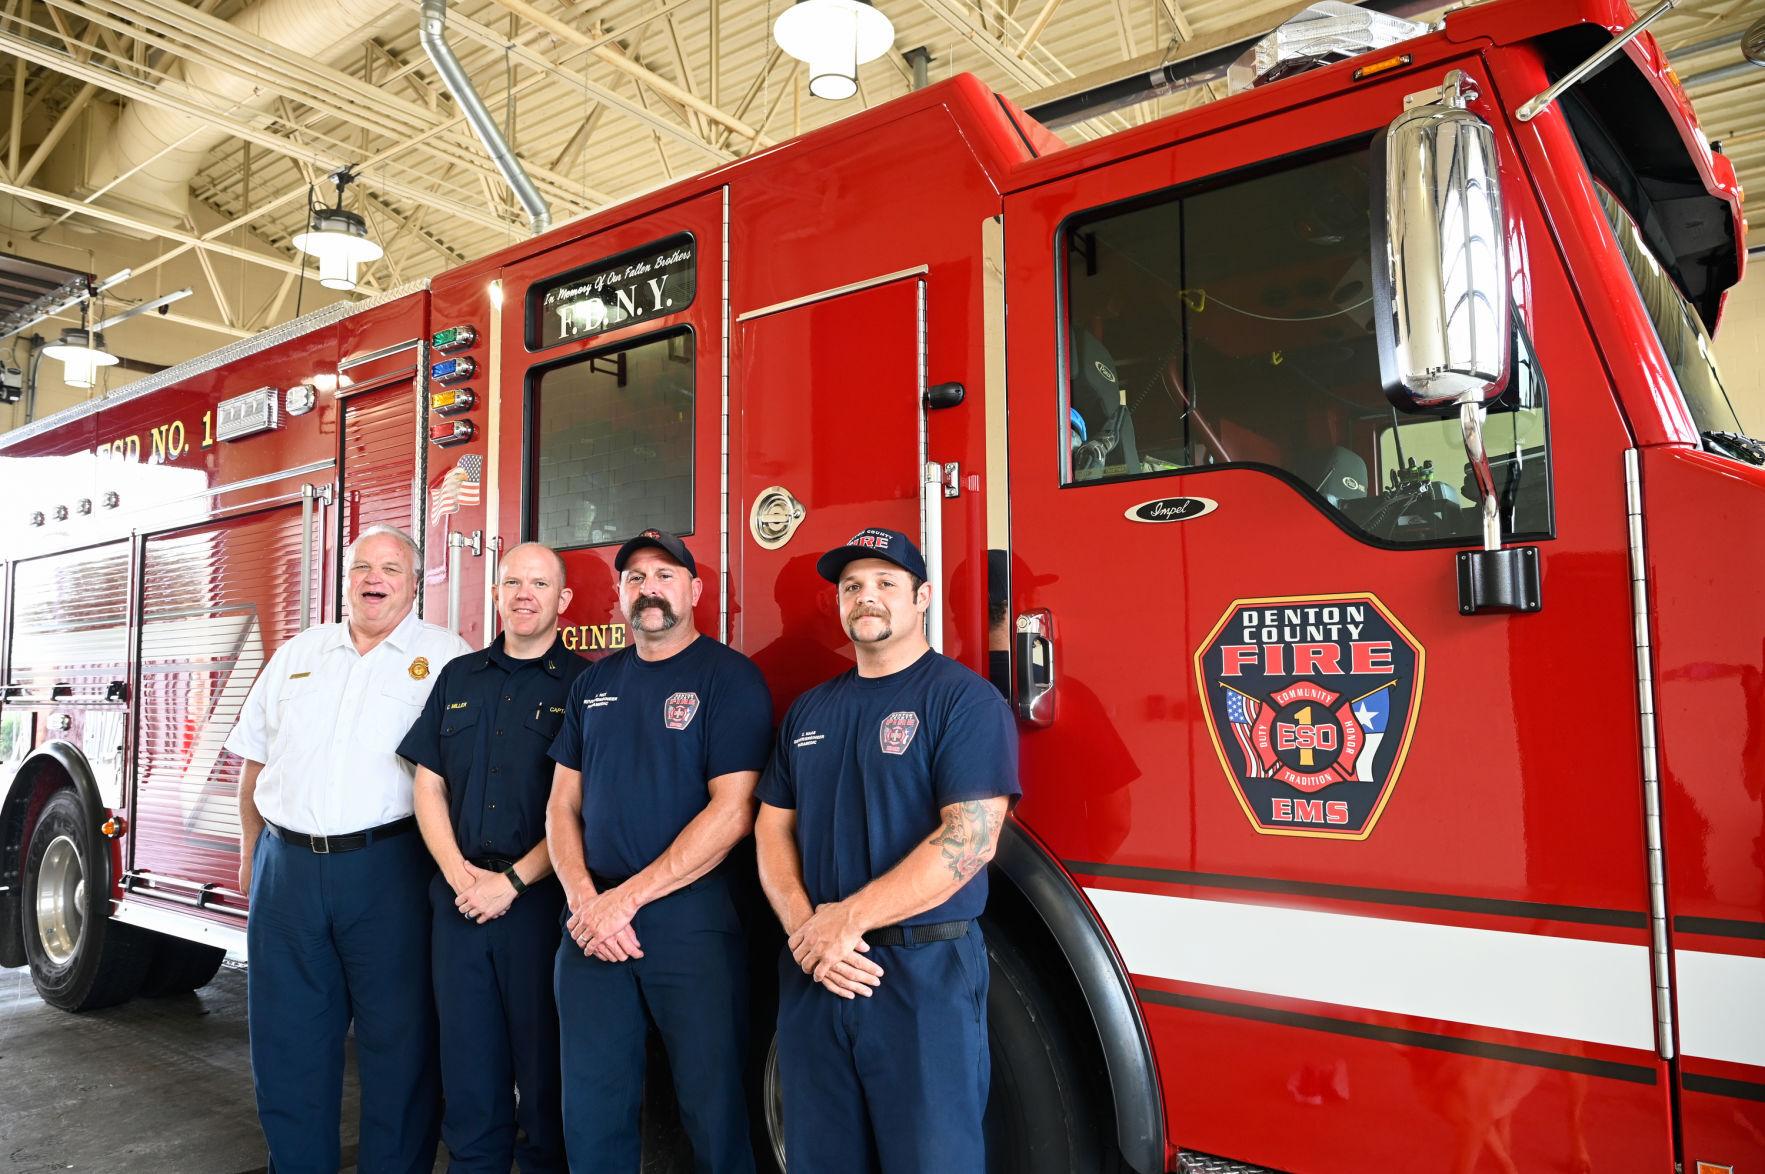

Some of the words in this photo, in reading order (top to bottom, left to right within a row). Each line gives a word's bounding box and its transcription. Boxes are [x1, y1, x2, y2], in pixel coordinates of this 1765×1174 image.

[543, 293, 555, 306] In
[557, 283, 592, 301] Memory
[594, 276, 605, 292] Of
[606, 271, 622, 285] Our
[624, 263, 652, 280] Fallen
[654, 250, 692, 269] Brothers
[149, 420, 190, 464] NO.
[202, 410, 213, 447] 1
[1150, 499, 1191, 520] Impel
[866, 529, 894, 540] COUNTY
[1243, 606, 1365, 627] DENTON
[557, 623, 626, 650] GINE
[1243, 624, 1364, 643] COUNTY
[1220, 640, 1395, 677] FIRE
[1276, 688, 1333, 705] COMMUNITY
[1259, 724, 1268, 748] DUTY
[1277, 722, 1337, 751] ESD
[1294, 706, 1315, 766] 1
[1344, 720, 1356, 755] HONOR
[1284, 771, 1333, 786] TRADITION
[1271, 798, 1349, 825] EMS
